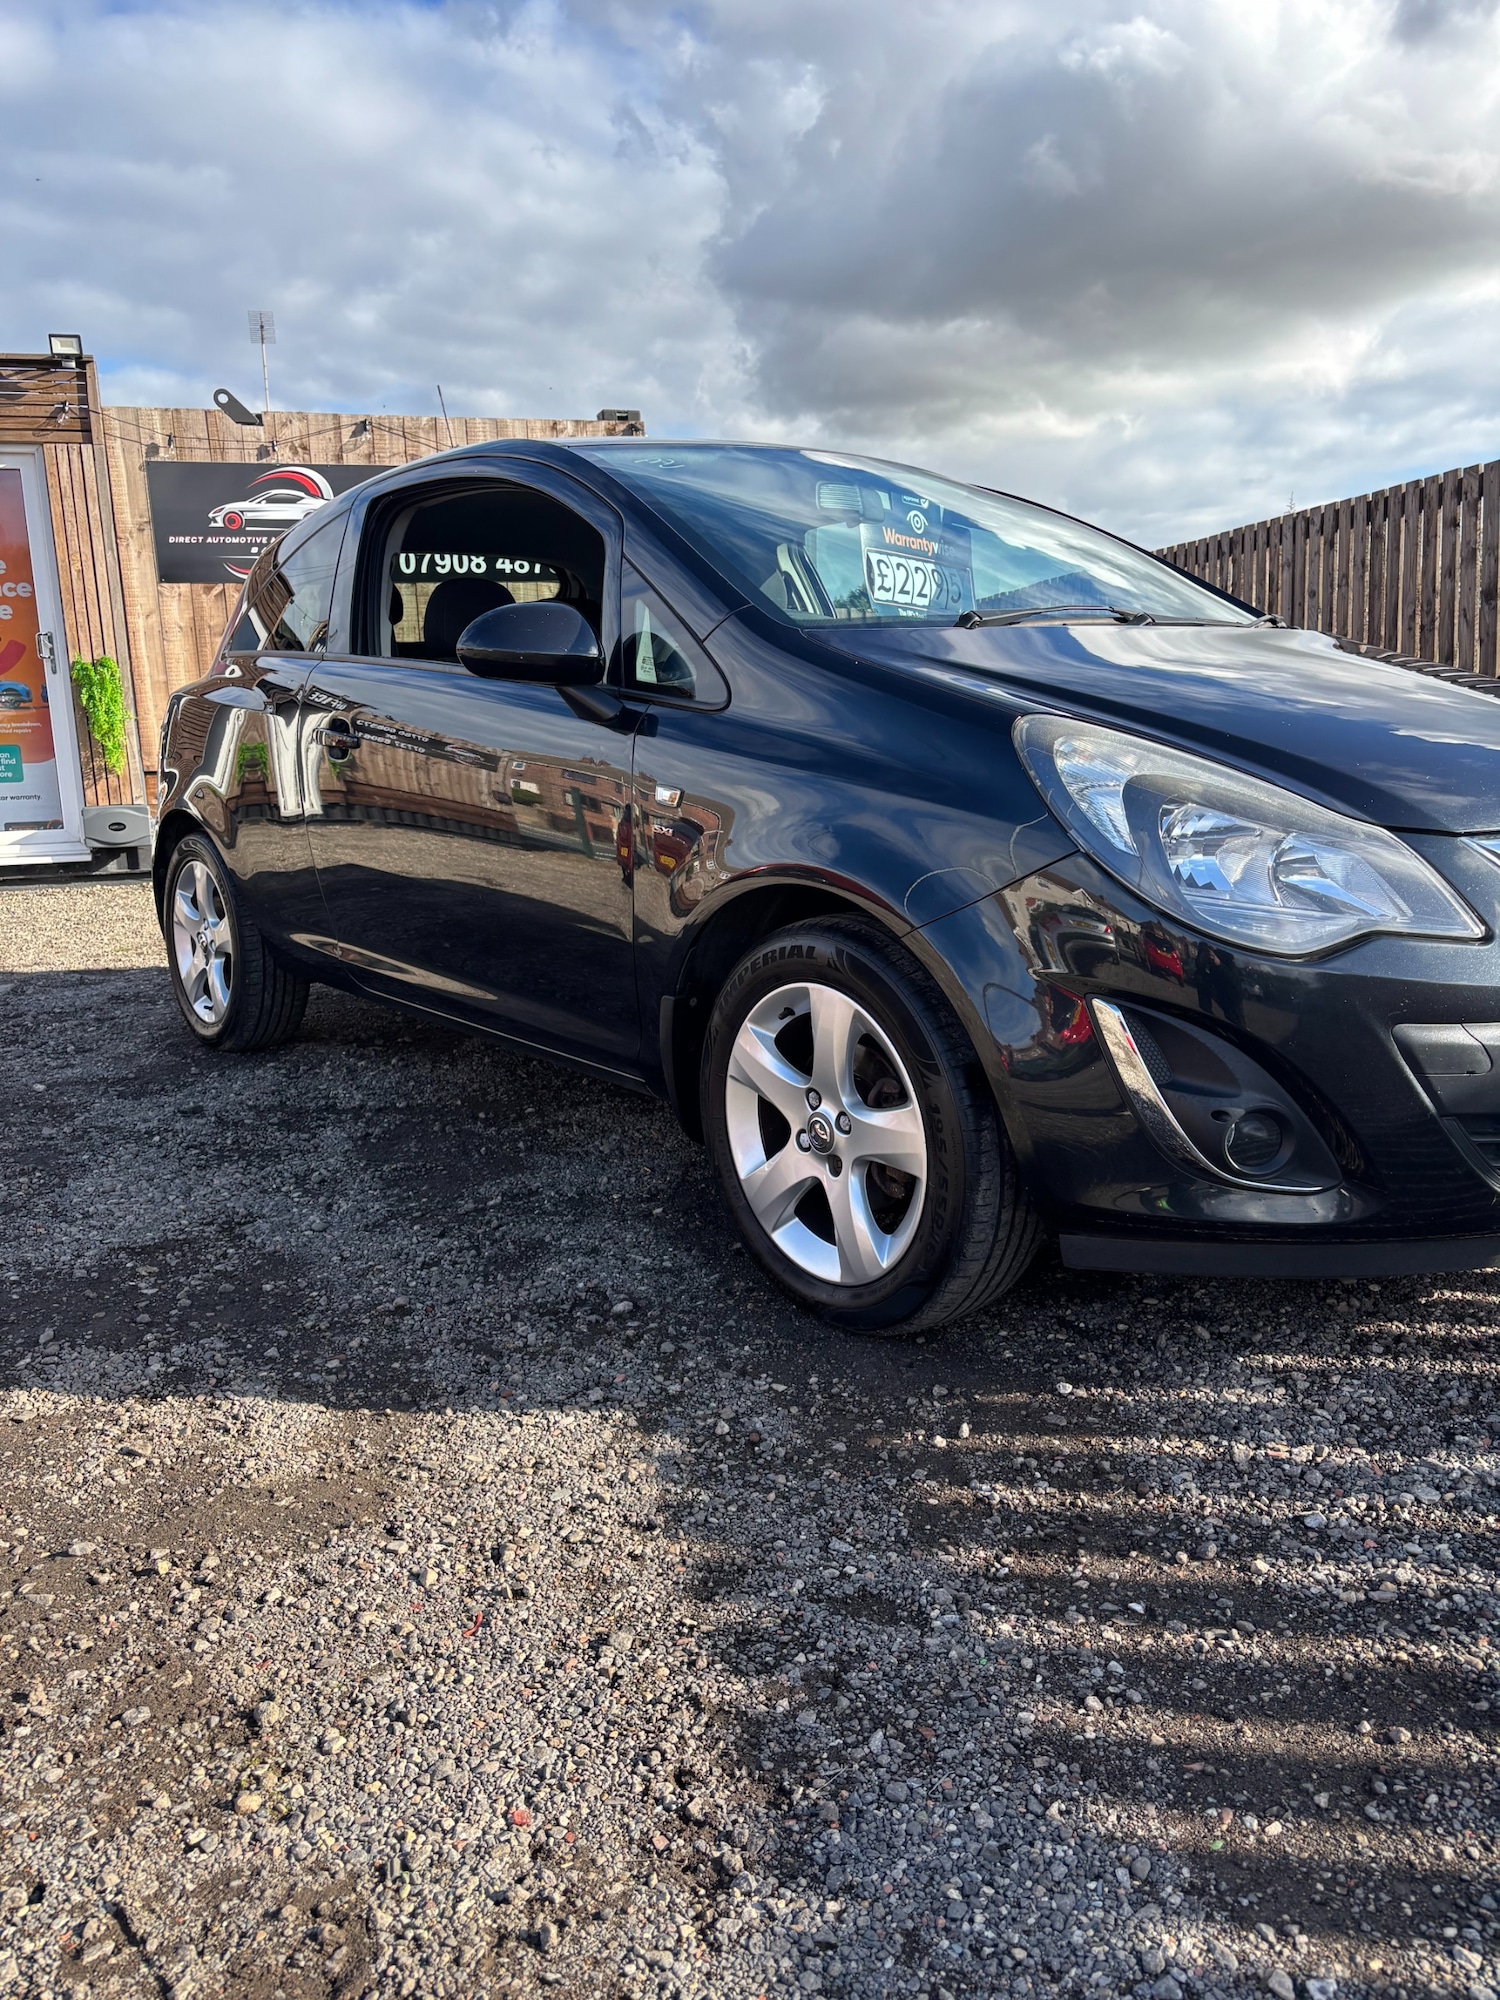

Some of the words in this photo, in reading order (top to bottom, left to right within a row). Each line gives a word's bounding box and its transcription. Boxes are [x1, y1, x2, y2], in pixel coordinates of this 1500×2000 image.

[168, 535, 204, 544] DIRECT
[206, 535, 268, 544] AUTOMOTIVE
[0, 582, 32, 597] ce
[716, 944, 818, 1018] IMPERIAL
